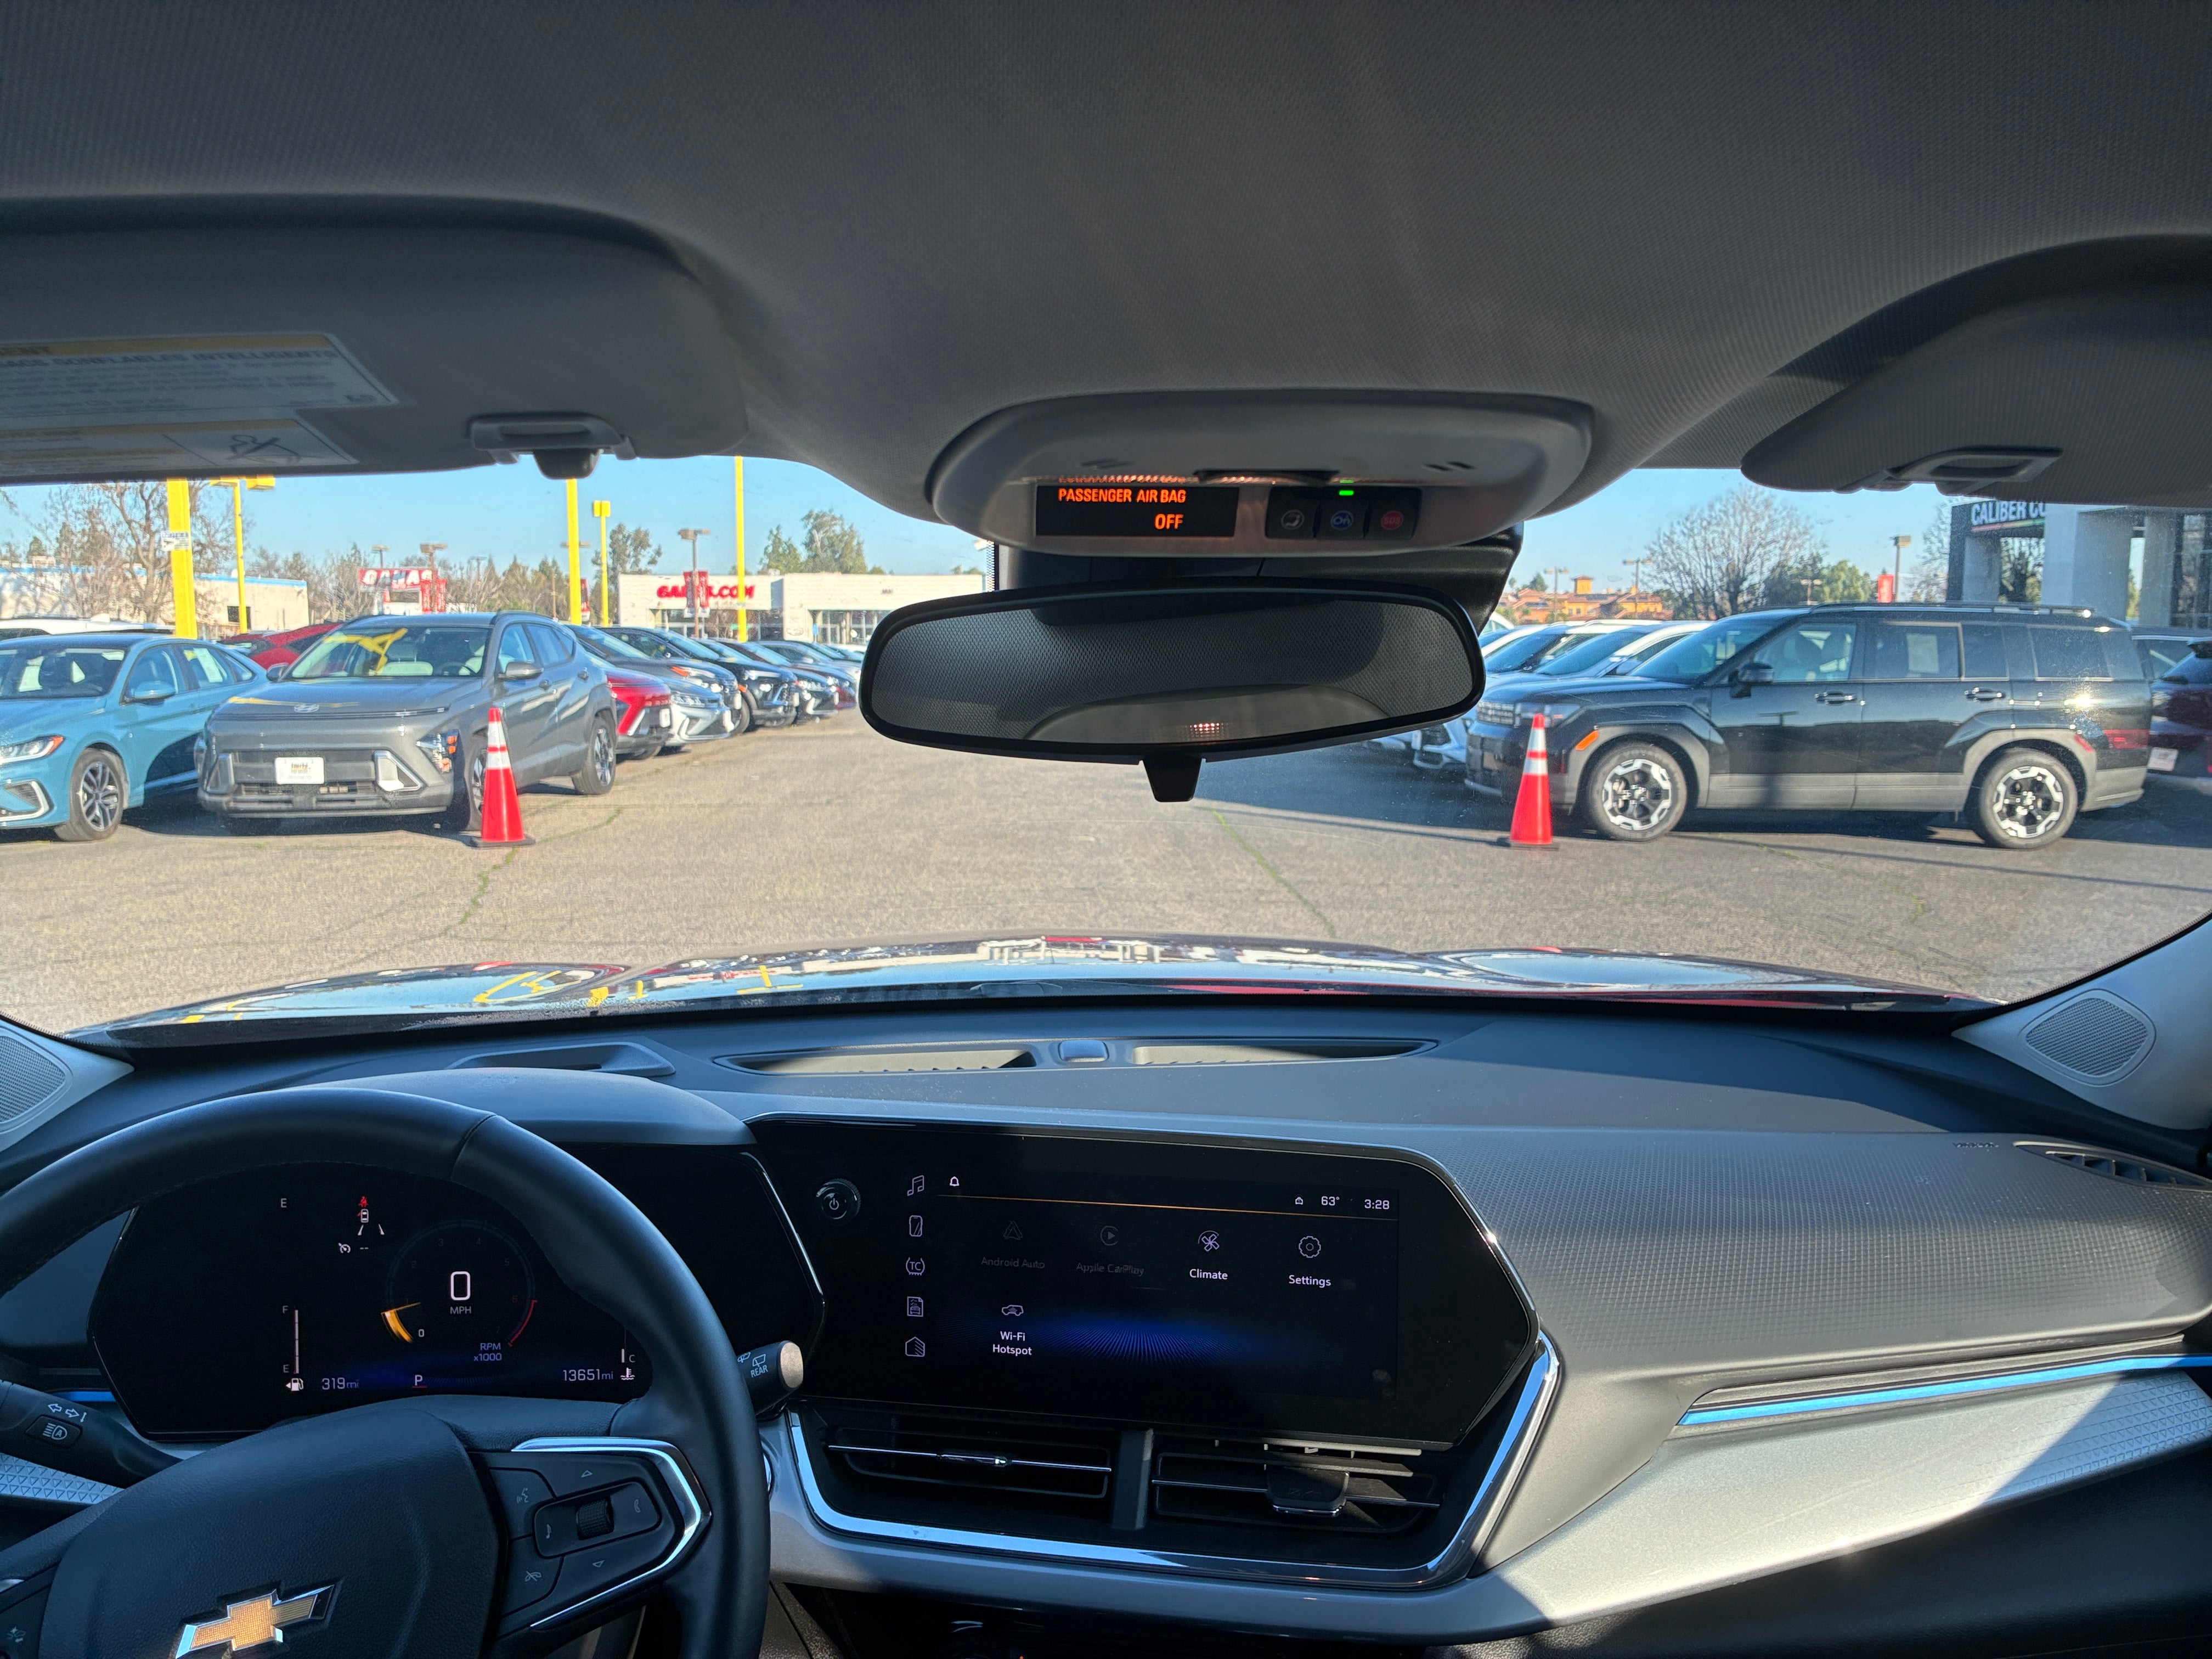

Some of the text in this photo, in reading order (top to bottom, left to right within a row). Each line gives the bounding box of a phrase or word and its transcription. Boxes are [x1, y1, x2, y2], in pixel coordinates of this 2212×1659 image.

[1058, 488, 1186, 503] PASSENGER AIR BAG
[1971, 500, 2027, 525] CALIBER
[1155, 514, 1184, 530] OFF
[1384, 517, 1401, 525] SOS
[281, 1198, 287, 1207] E
[1321, 1195, 1340, 1206] 63°
[1364, 1199, 1390, 1210] 3:28
[438, 1238, 443, 1246] 3
[476, 1237, 482, 1245] 4
[411, 1260, 417, 1268] 2
[504, 1258, 510, 1266] 5
[910, 1262, 921, 1271] TC
[981, 1257, 1045, 1269] Android Auto
[1076, 1262, 1105, 1273] Apple
[1189, 1268, 1228, 1280] Climate
[1288, 1274, 1331, 1288] Settings
[450, 1271, 471, 1301] 0
[282, 1305, 289, 1314] F
[450, 1306, 472, 1314] MPH
[418, 1329, 425, 1338] 0
[1000, 1331, 1026, 1341] Wi-Fi
[480, 1342, 501, 1351] RPM
[992, 1344, 1032, 1357] Hotspot
[473, 1353, 502, 1362] x1000
[629, 1355, 635, 1363] C
[283, 1364, 290, 1373] E
[750, 1364, 768, 1378] REAR
[415, 1374, 423, 1386] P
[55, 1429, 63, 1437] A
